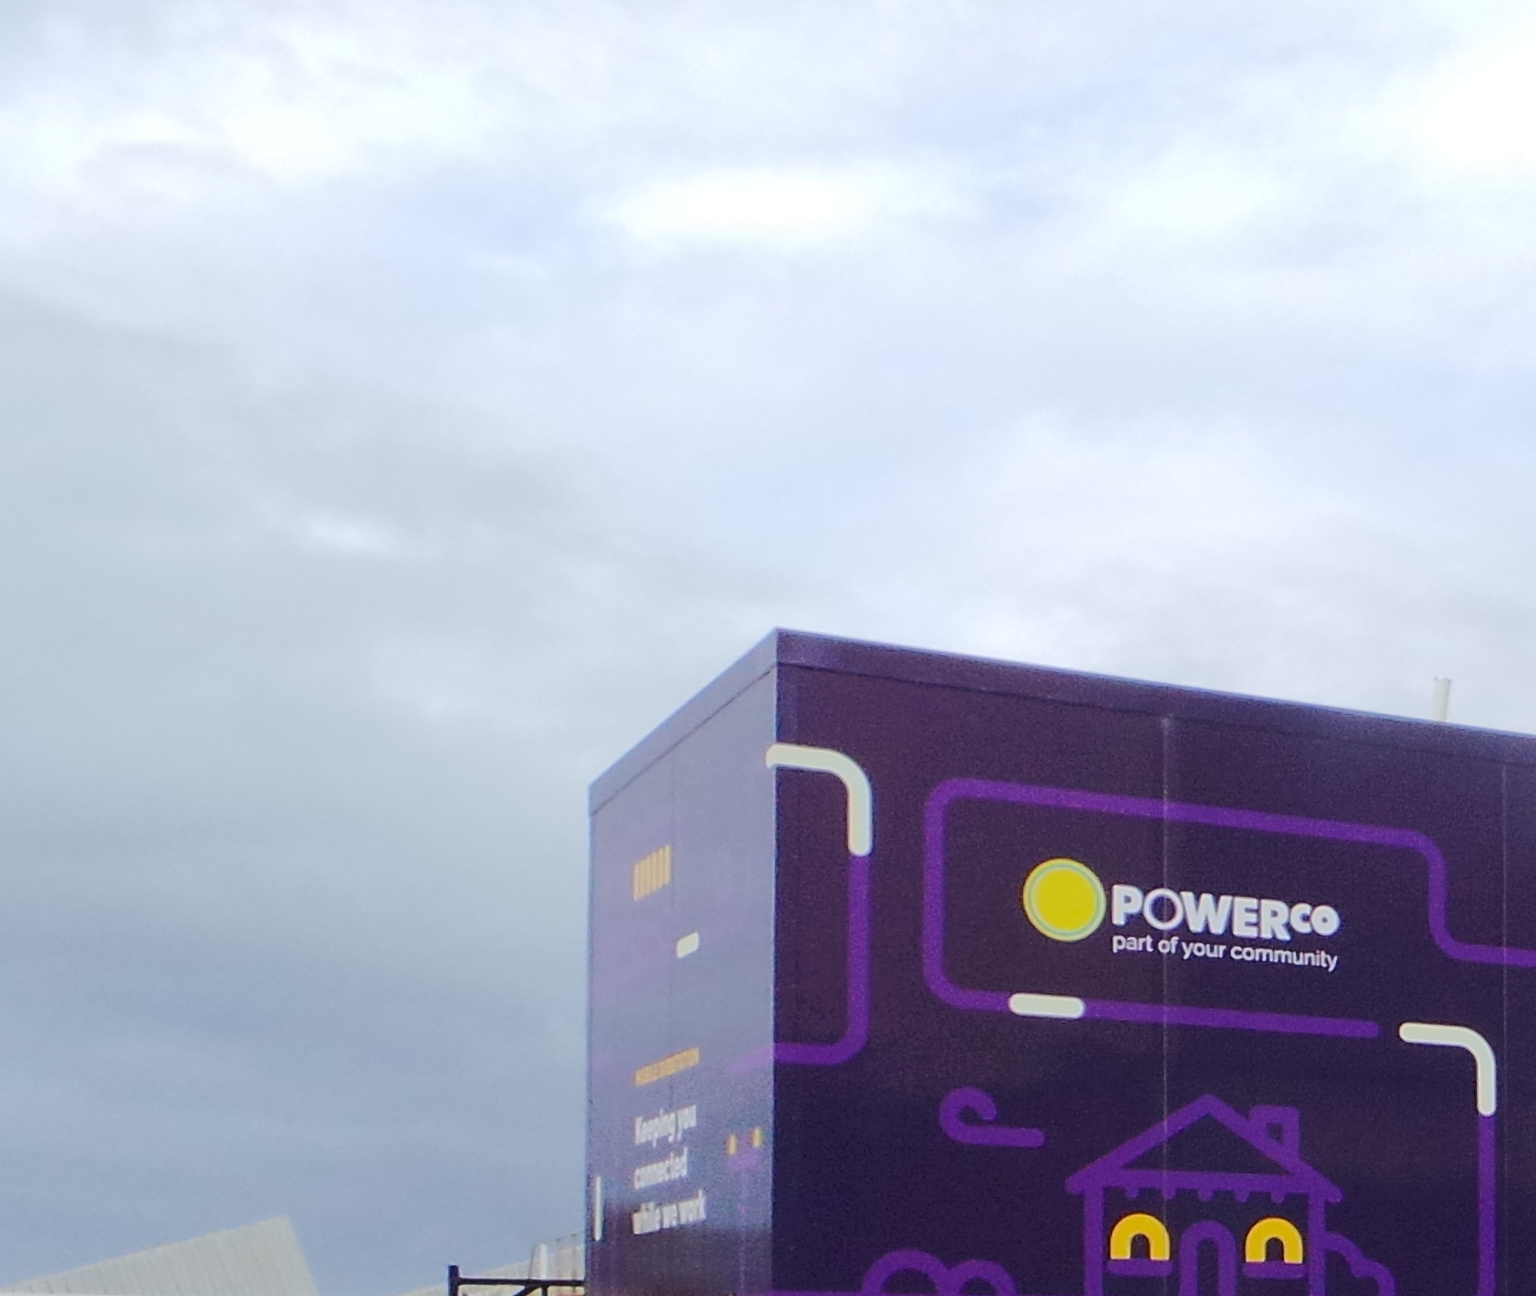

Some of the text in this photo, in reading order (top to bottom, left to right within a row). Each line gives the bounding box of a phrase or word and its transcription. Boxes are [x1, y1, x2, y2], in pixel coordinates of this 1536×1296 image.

[1112, 934, 1339, 972] part of your community
[634, 1108, 675, 1148] Keeping
[634, 1147, 688, 1190] connected
